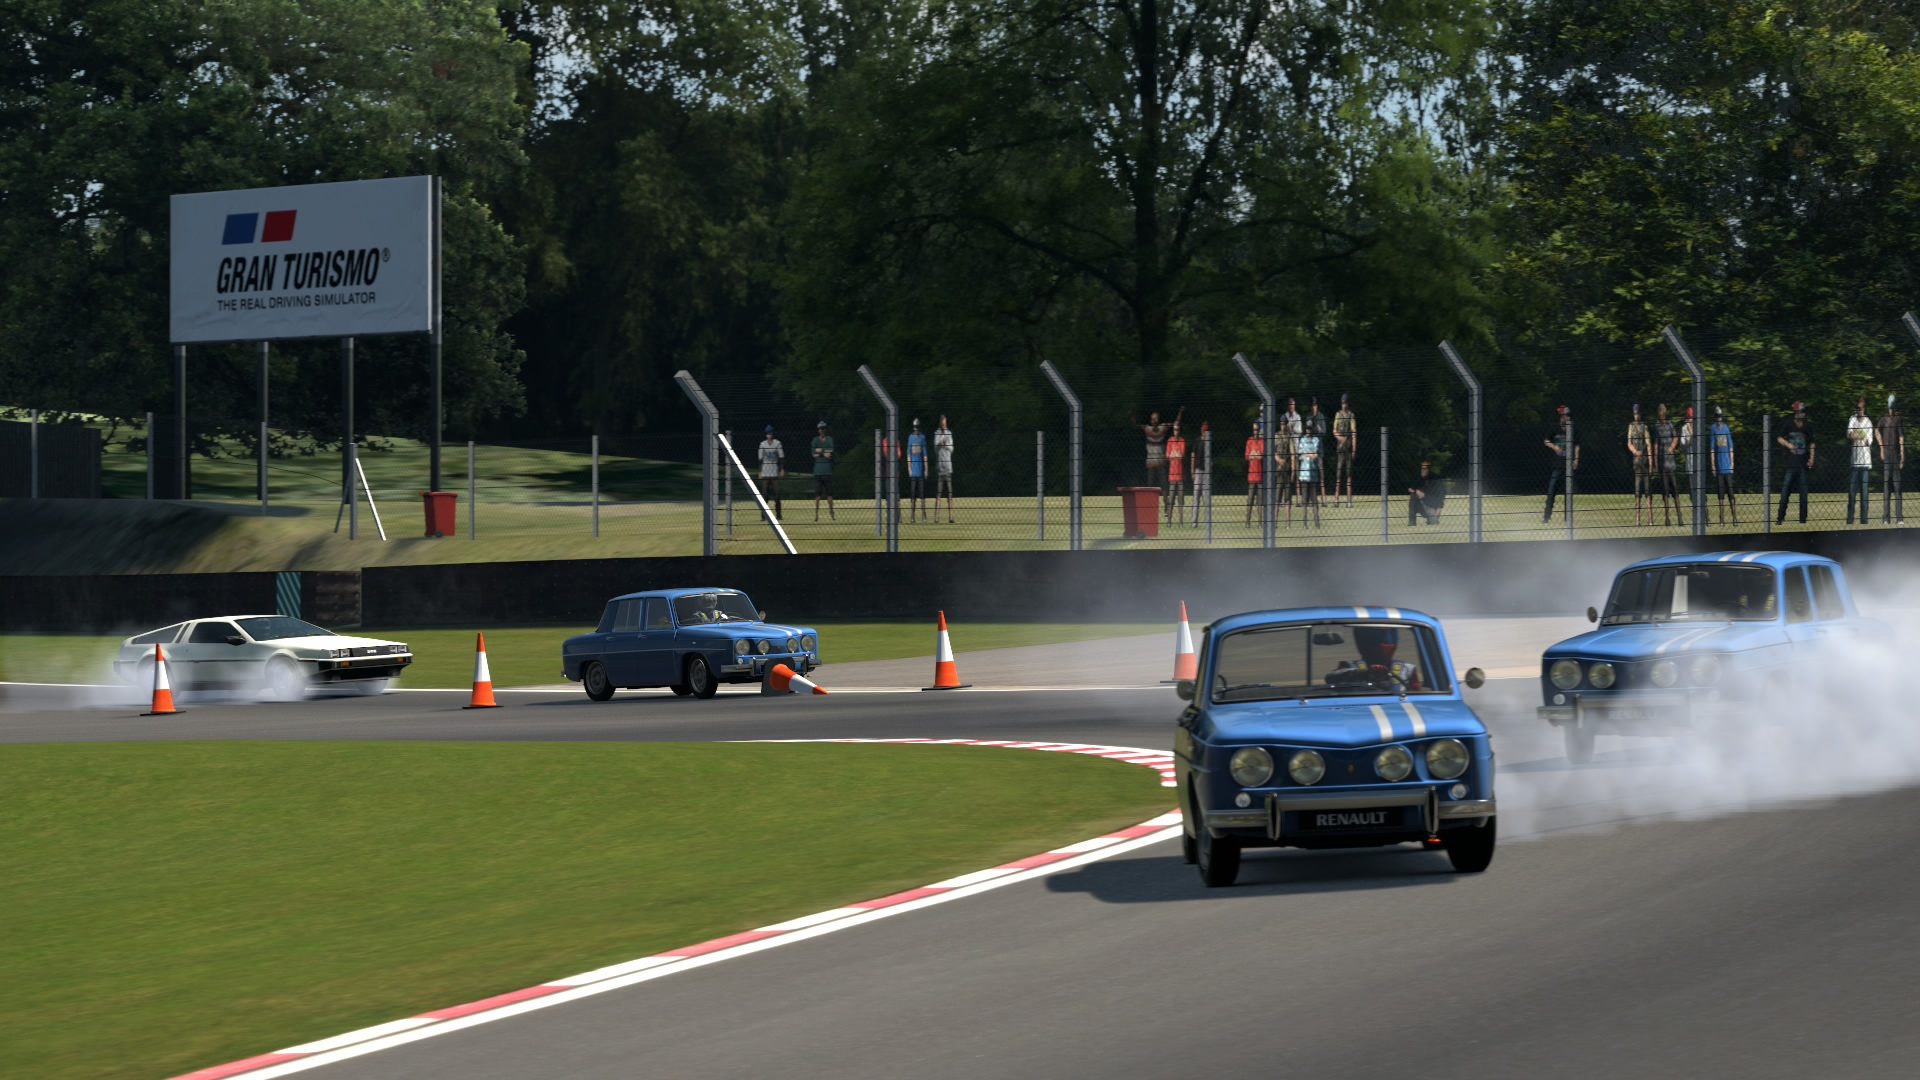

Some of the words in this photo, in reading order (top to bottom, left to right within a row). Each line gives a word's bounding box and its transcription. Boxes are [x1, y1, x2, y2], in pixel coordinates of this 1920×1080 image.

[217, 254, 278, 294] GRAN
[217, 299, 237, 311] THE
[240, 298, 267, 310] REAL
[269, 295, 312, 309] DRIVING
[314, 291, 376, 307] SIMULATOR
[1316, 811, 1388, 826] RENAULT
